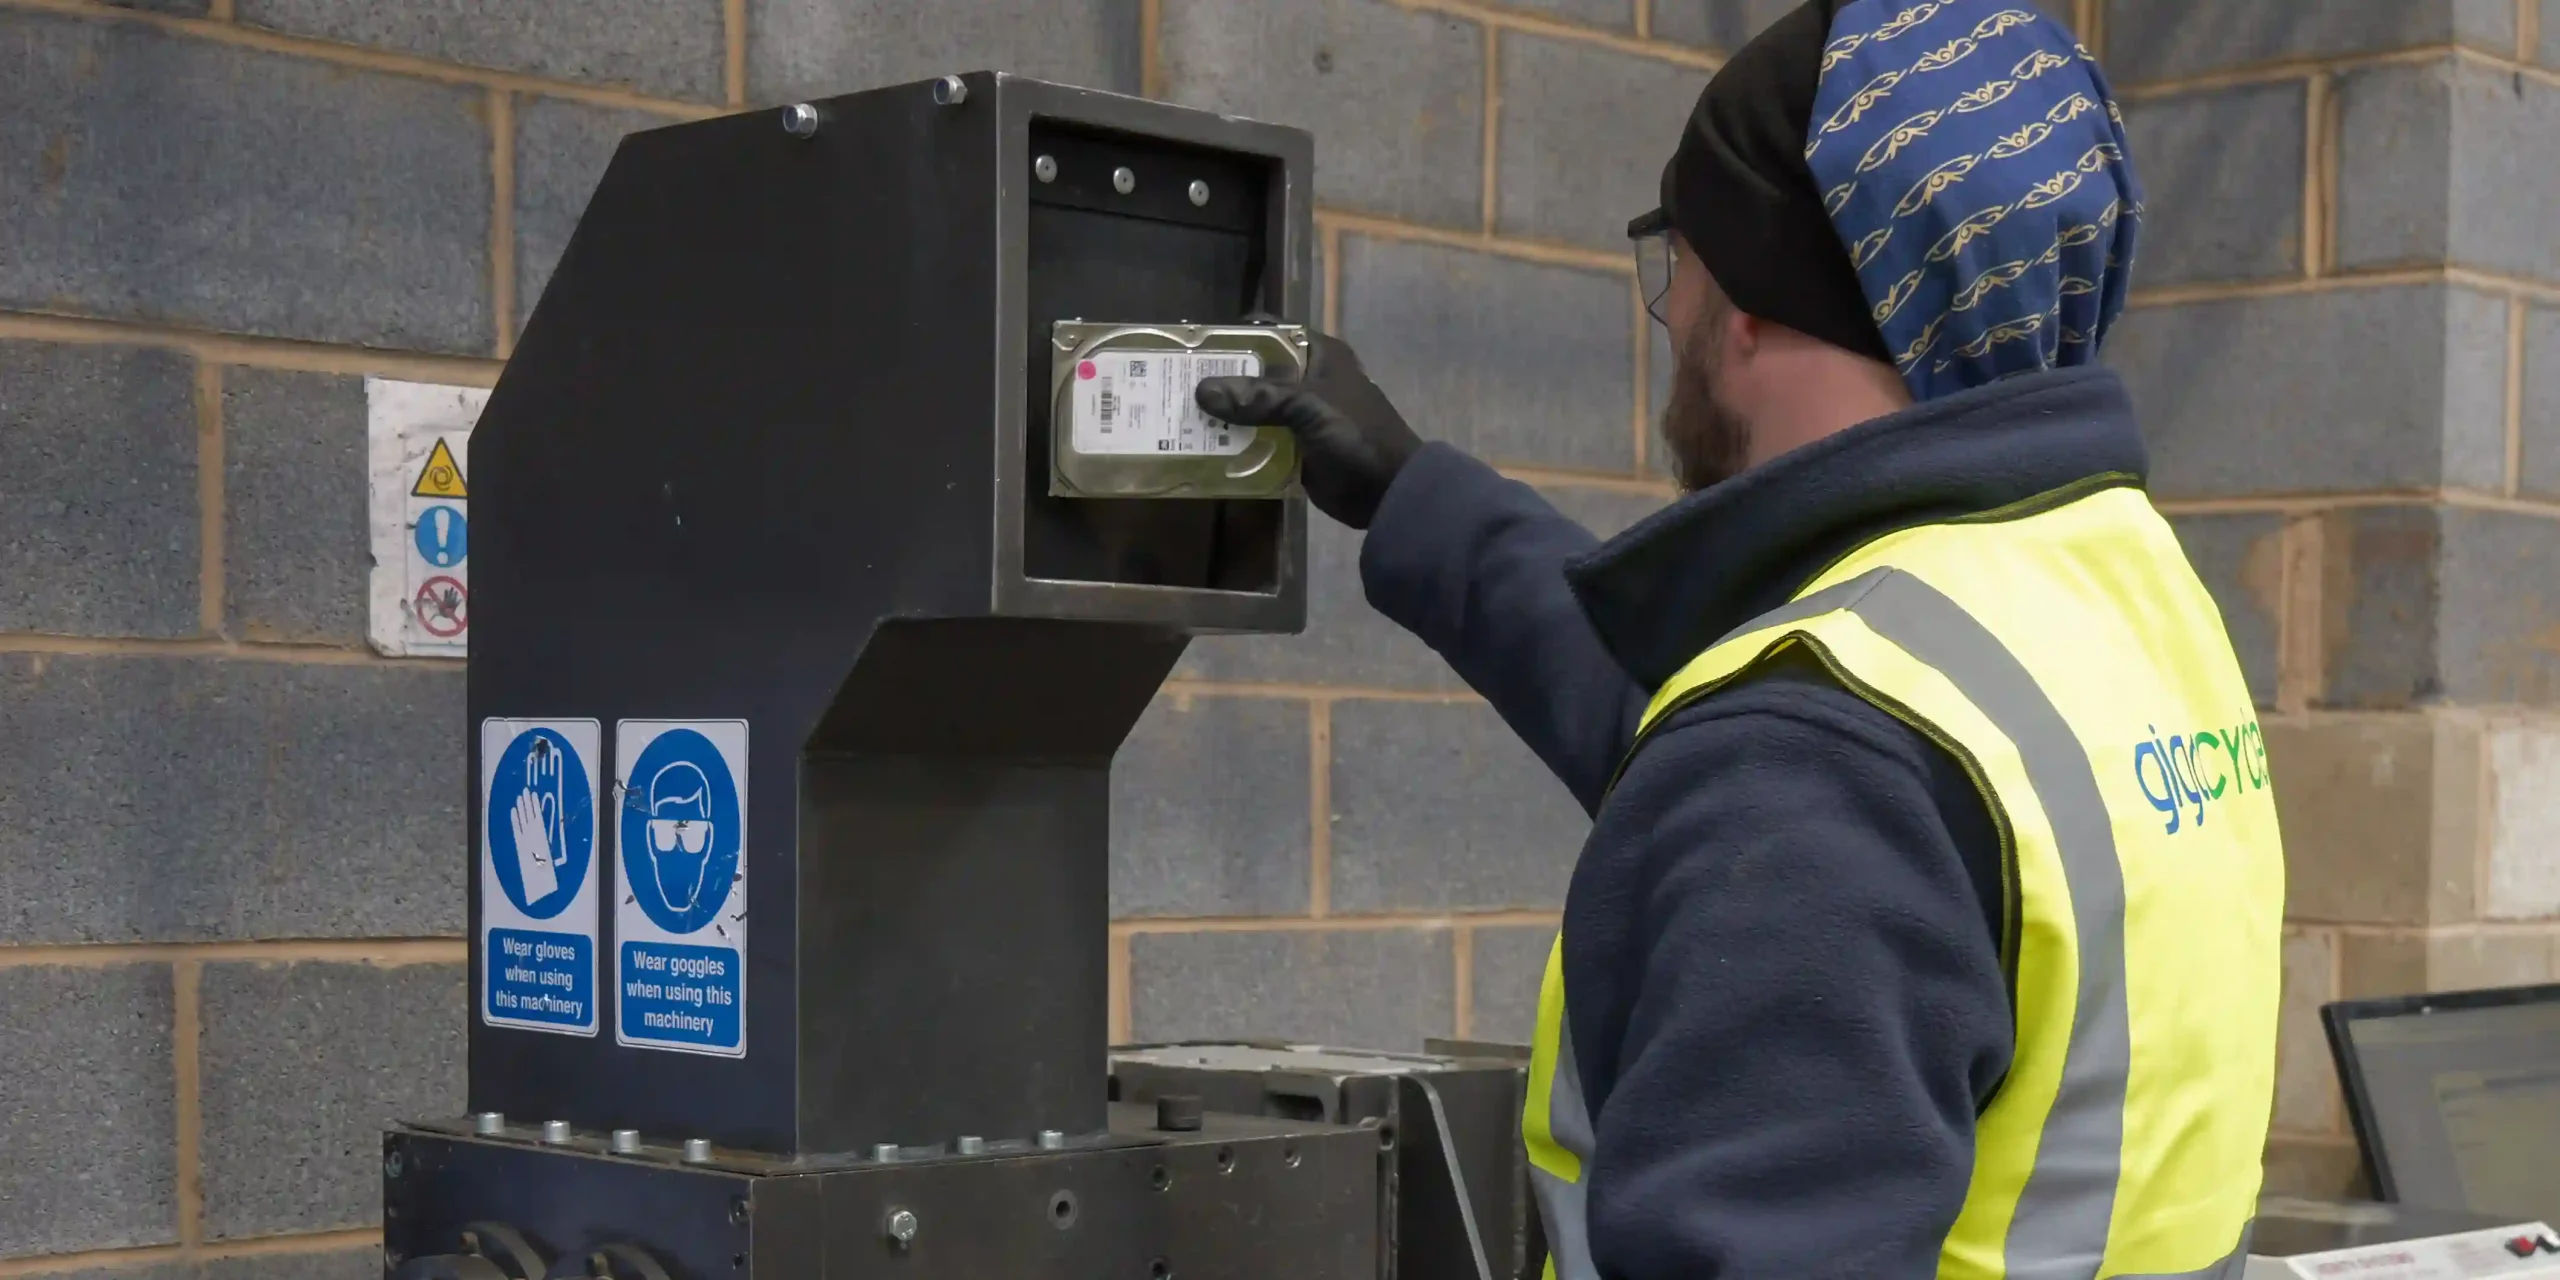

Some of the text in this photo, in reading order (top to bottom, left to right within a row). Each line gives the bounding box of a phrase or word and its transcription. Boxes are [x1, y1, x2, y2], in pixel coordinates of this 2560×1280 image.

[503, 937, 576, 962] Wear gloves
[504, 965, 573, 992] when using
[633, 950, 725, 979] Wear goggles
[495, 989, 584, 1020] this machinery
[626, 979, 732, 1008] when using this
[643, 1010, 714, 1037] machinery
